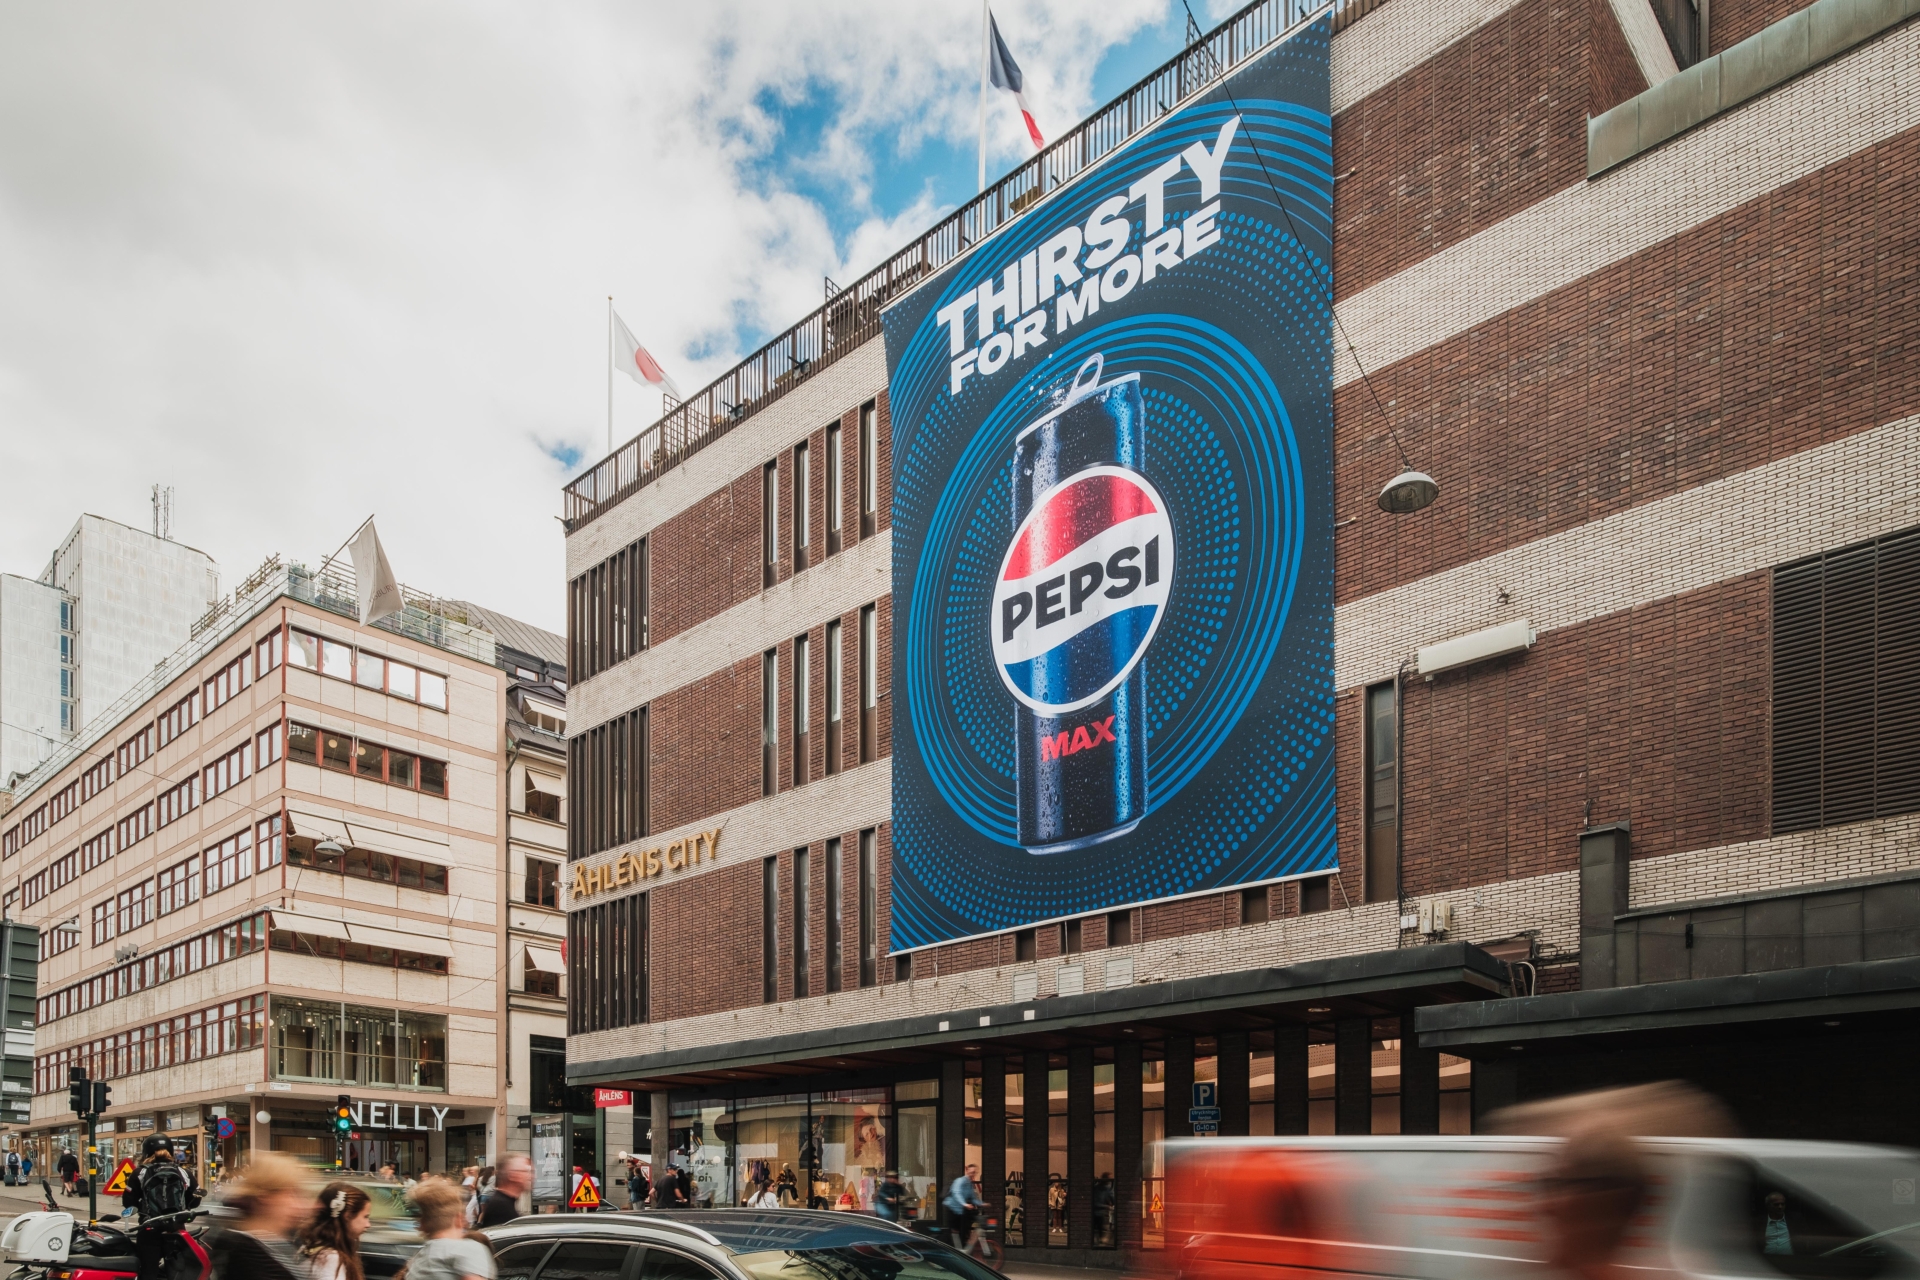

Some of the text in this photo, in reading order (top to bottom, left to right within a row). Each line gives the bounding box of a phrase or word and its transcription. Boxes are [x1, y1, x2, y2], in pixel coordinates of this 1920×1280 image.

[937, 113, 1242, 357] THIRSTY
[951, 199, 1221, 396] FOR MORE
[1002, 533, 1159, 644] PEPSI
[1041, 715, 1117, 763] MAX
[572, 828, 721, 899] ÅHLÉNS CITY
